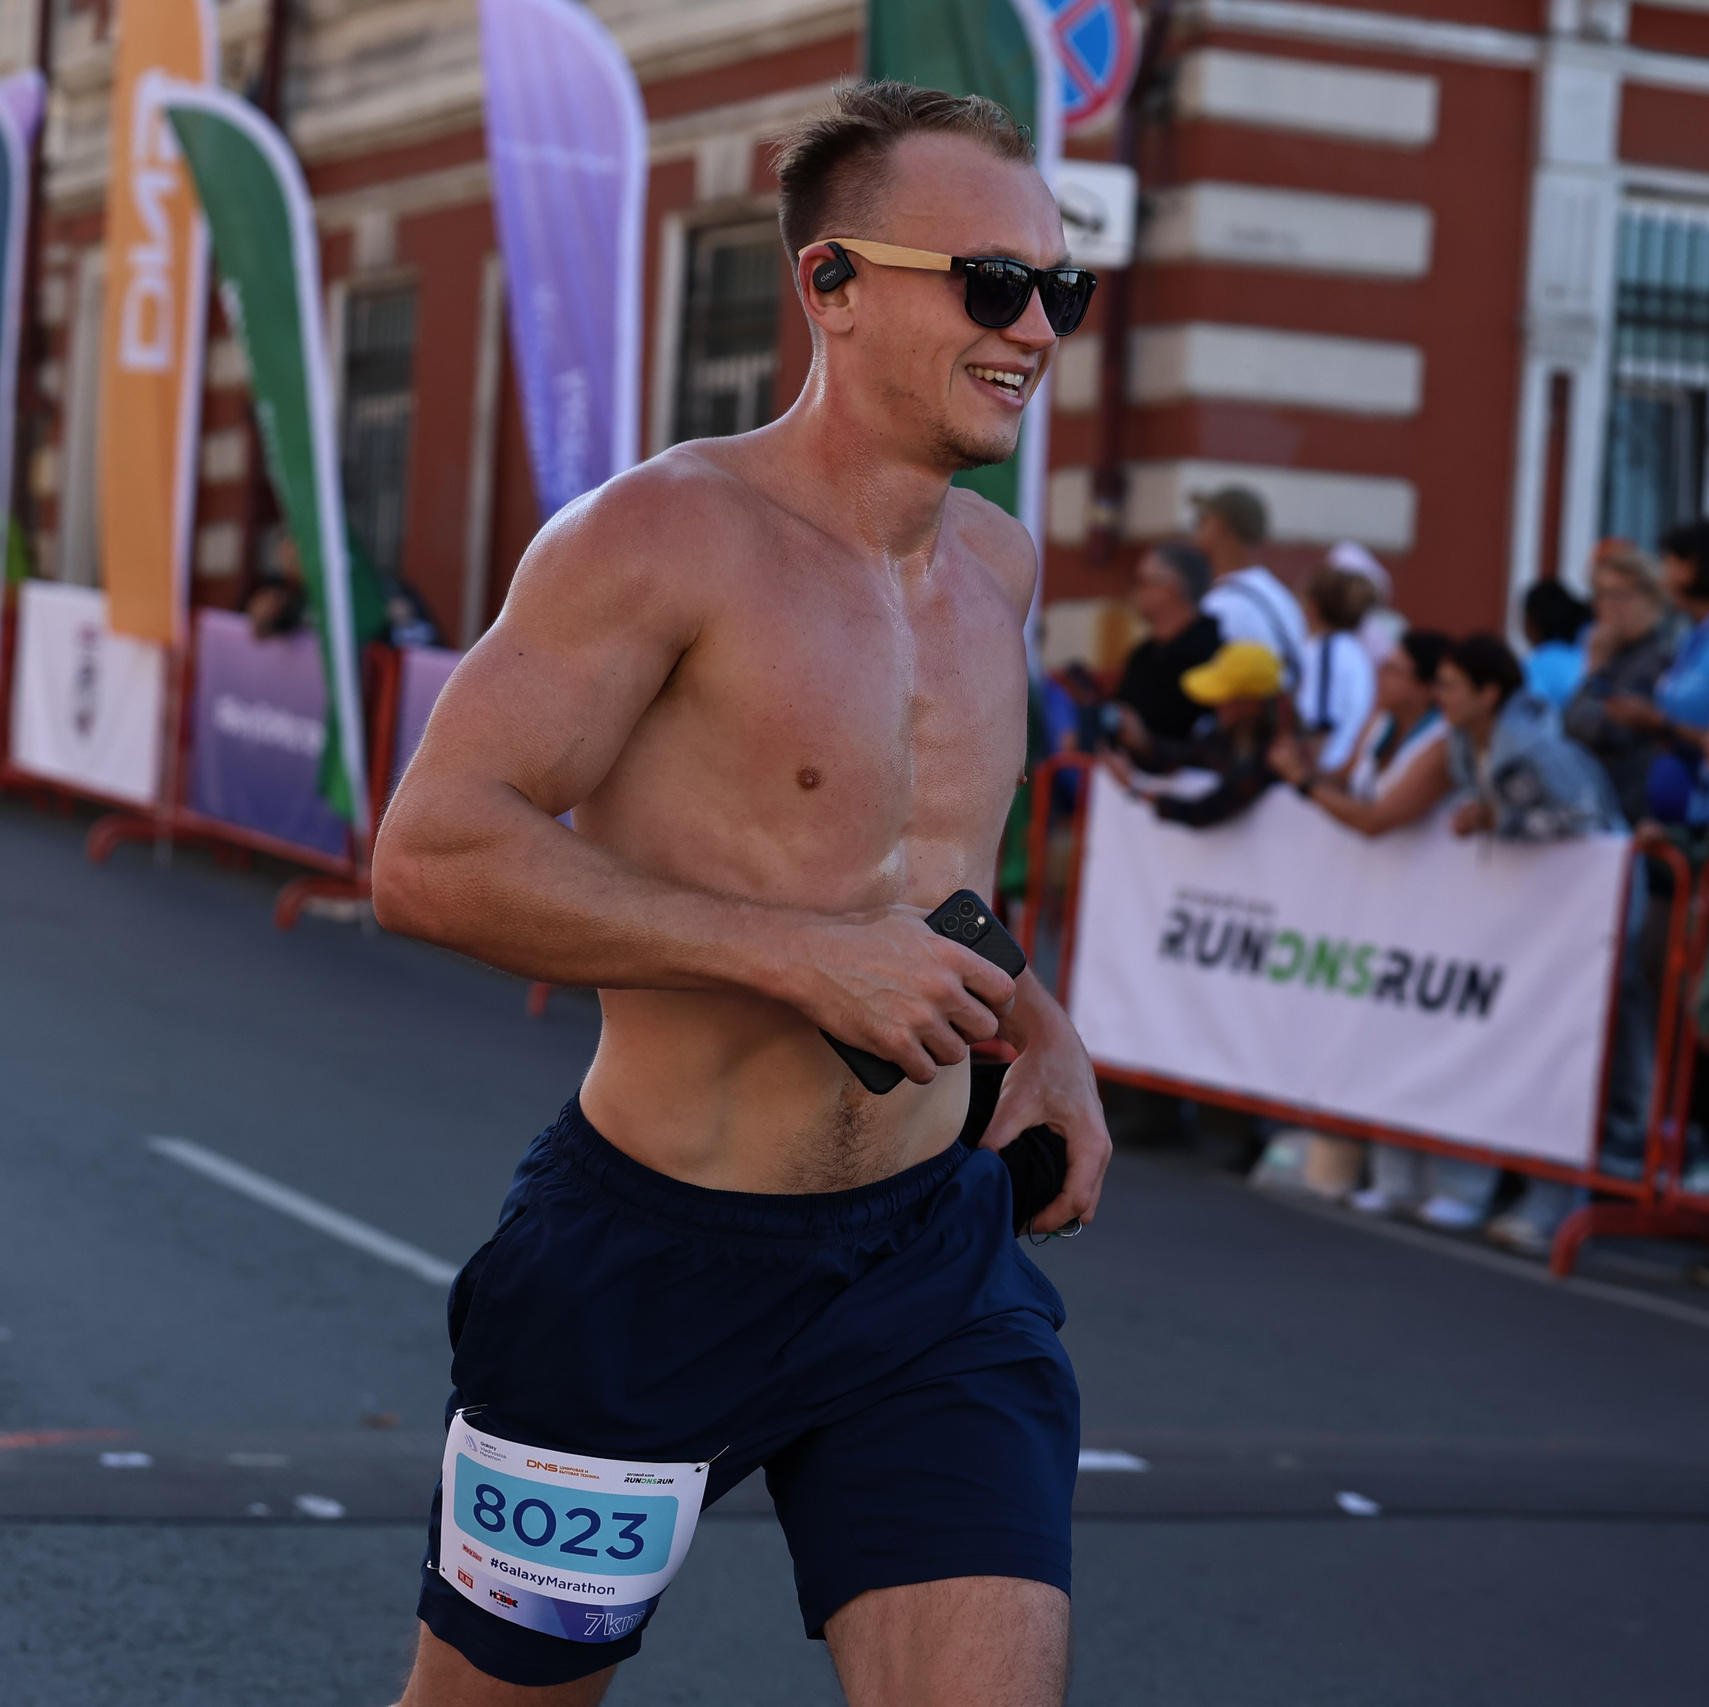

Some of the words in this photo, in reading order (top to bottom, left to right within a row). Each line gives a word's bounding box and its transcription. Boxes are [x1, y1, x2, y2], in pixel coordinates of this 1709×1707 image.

[1159, 906, 1504, 1021] RUNDNSRUN
[480, 1441, 497, 1451] Galaxy
[526, 1459, 558, 1472] DNS
[624, 1477, 675, 1485] RUNDNSRUN
[473, 1483, 648, 1560] 8023
[490, 1557, 615, 1596] #GalaxyMarathon
